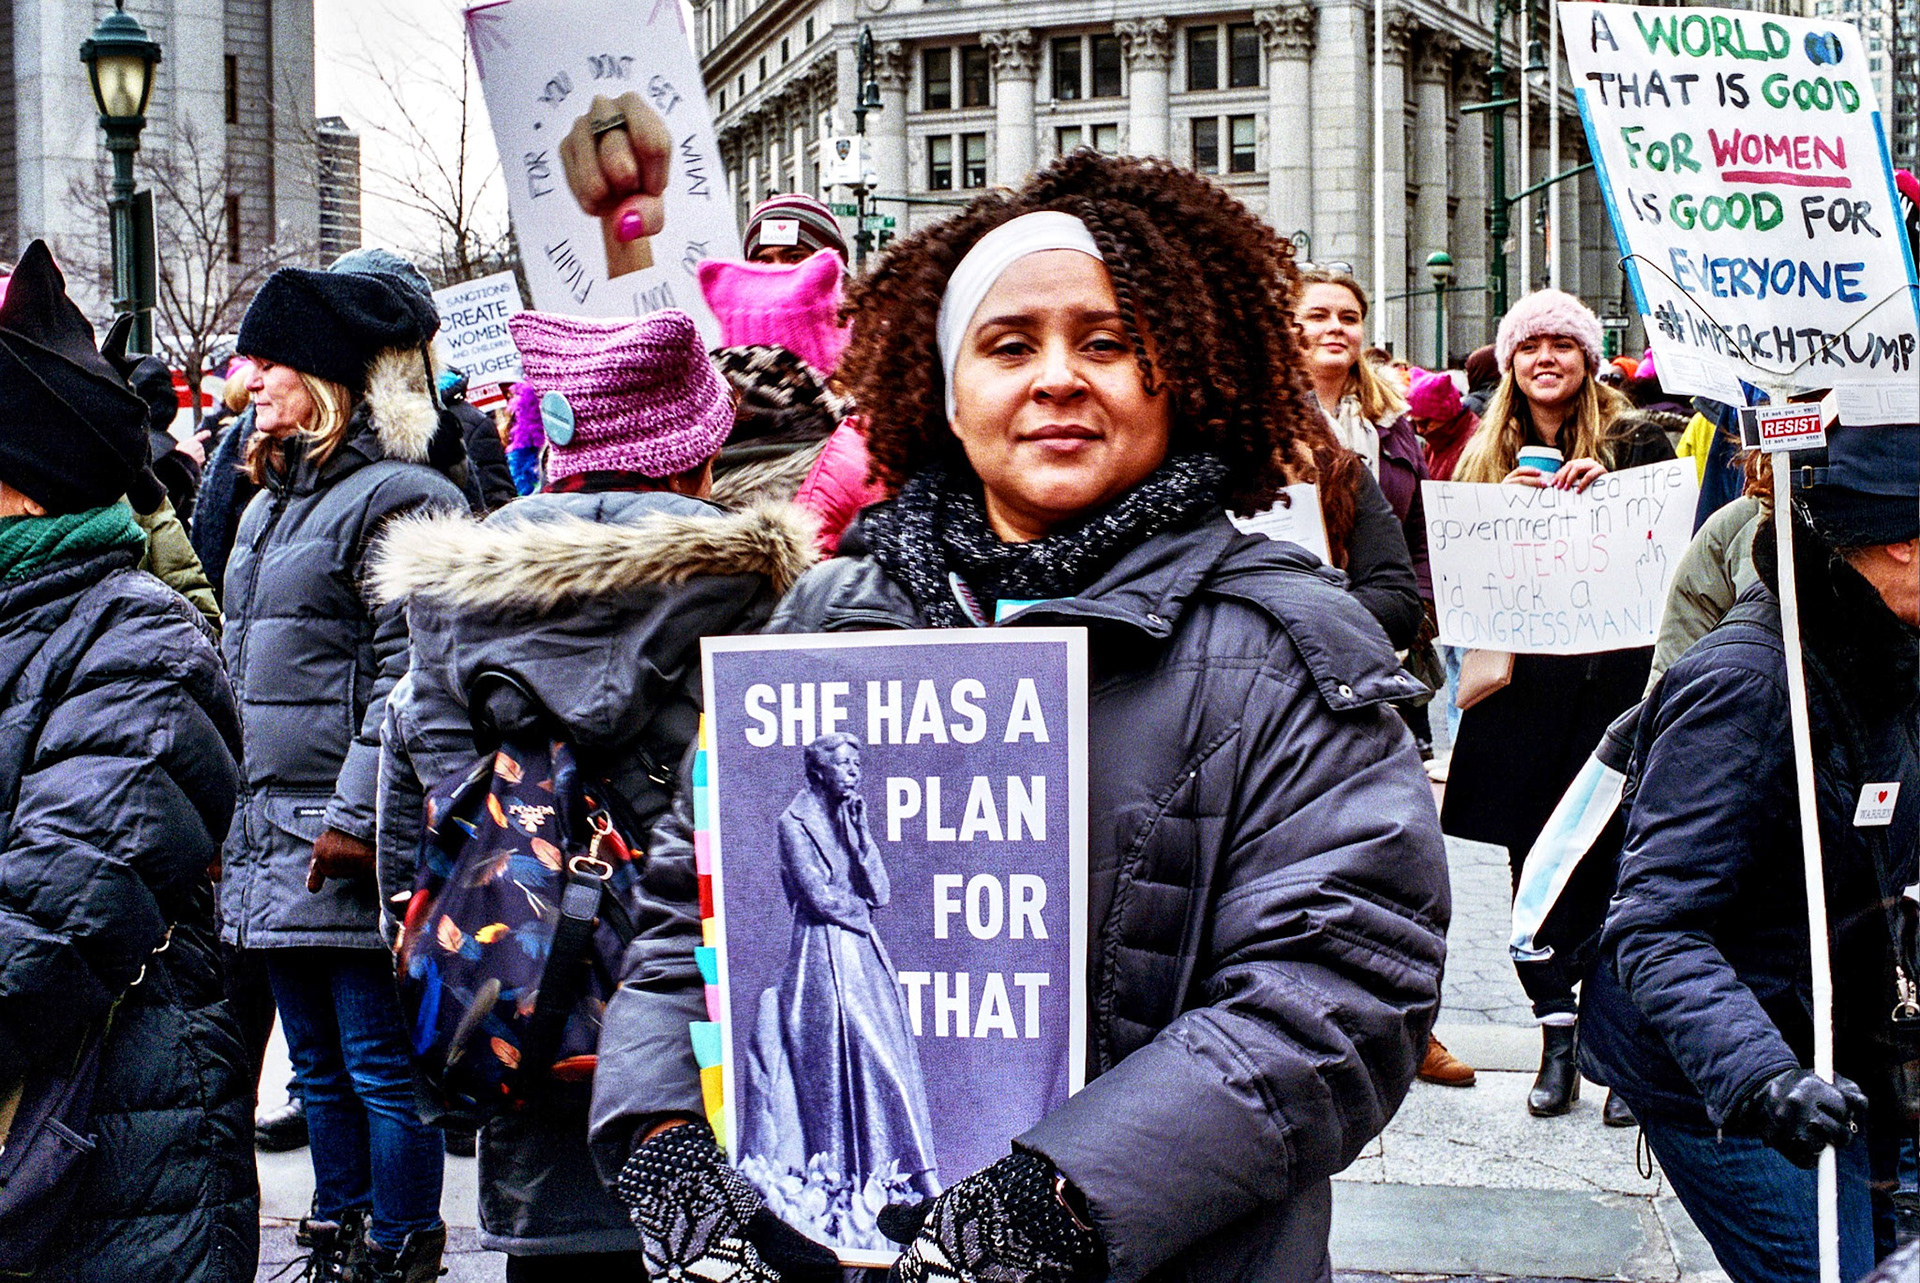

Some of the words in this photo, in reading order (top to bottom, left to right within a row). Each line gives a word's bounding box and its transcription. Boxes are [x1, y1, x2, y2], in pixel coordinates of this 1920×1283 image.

[1591, 10, 1619, 52] A
[1633, 11, 1791, 61] WORLD
[648, 75, 682, 116] GET
[1586, 69, 1699, 108] THAT
[1716, 72, 1750, 109] IS
[1761, 73, 1861, 113] GOOD
[524, 150, 554, 200] FOR
[680, 134, 711, 200] WHAT
[1620, 126, 1702, 174] FOR
[1707, 127, 1847, 171] WOMEN
[1628, 187, 1662, 225] IS
[1669, 191, 1783, 231] GOOD
[1800, 195, 1882, 239] FOR
[446, 283, 510, 307] SANCTIONS
[544, 238, 594, 305] FIGHT
[1669, 247, 1868, 303] EVERYONE
[440, 300, 509, 333] CREATE
[447, 322, 507, 349] WOMEN
[1764, 417, 1819, 436] RESIST
[1639, 465, 1682, 495] the
[1430, 509, 1577, 550] government
[1590, 504, 1612, 534] in
[1625, 493, 1669, 528] my
[1499, 533, 1610, 580] UTERUS
[1482, 572, 1546, 612] fuck
[1570, 580, 1592, 609] a
[744, 682, 849, 748] SHE
[867, 678, 987, 745] HAS
[1003, 678, 1050, 743] A
[886, 775, 1046, 842] PLAN
[933, 873, 1050, 940] FOR
[898, 971, 1050, 1039] THAT
